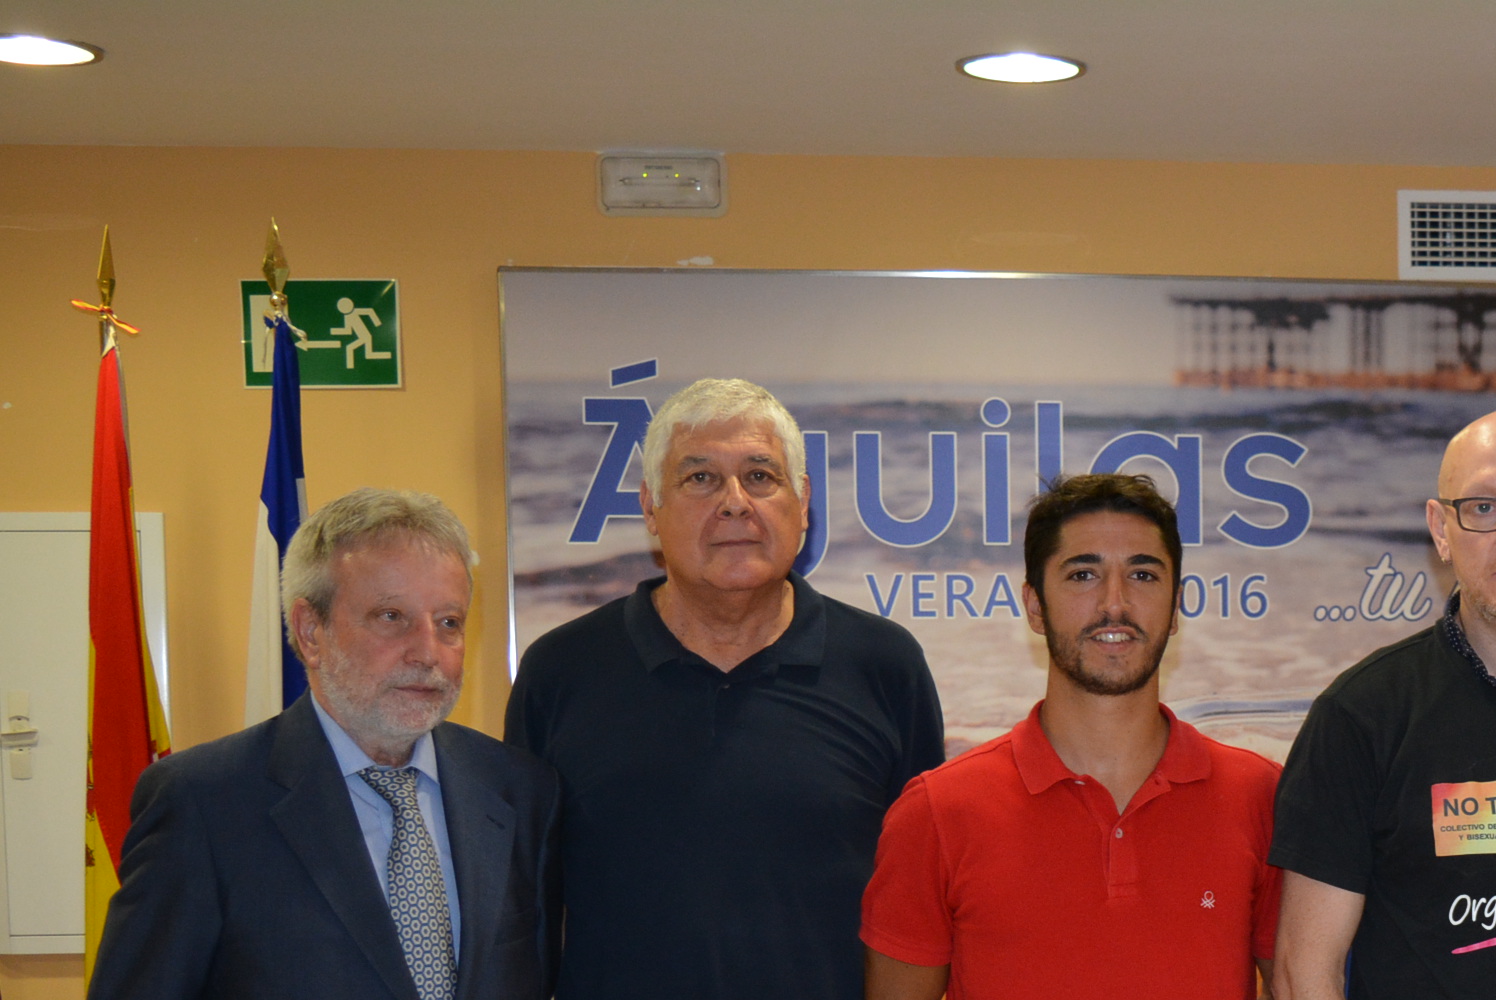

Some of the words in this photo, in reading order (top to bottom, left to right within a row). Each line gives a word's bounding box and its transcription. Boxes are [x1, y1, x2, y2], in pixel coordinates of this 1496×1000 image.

[568, 357, 1313, 581] Áuilas
[1443, 797, 1479, 817] NO
[1440, 823, 1485, 833] COLECTIVO
